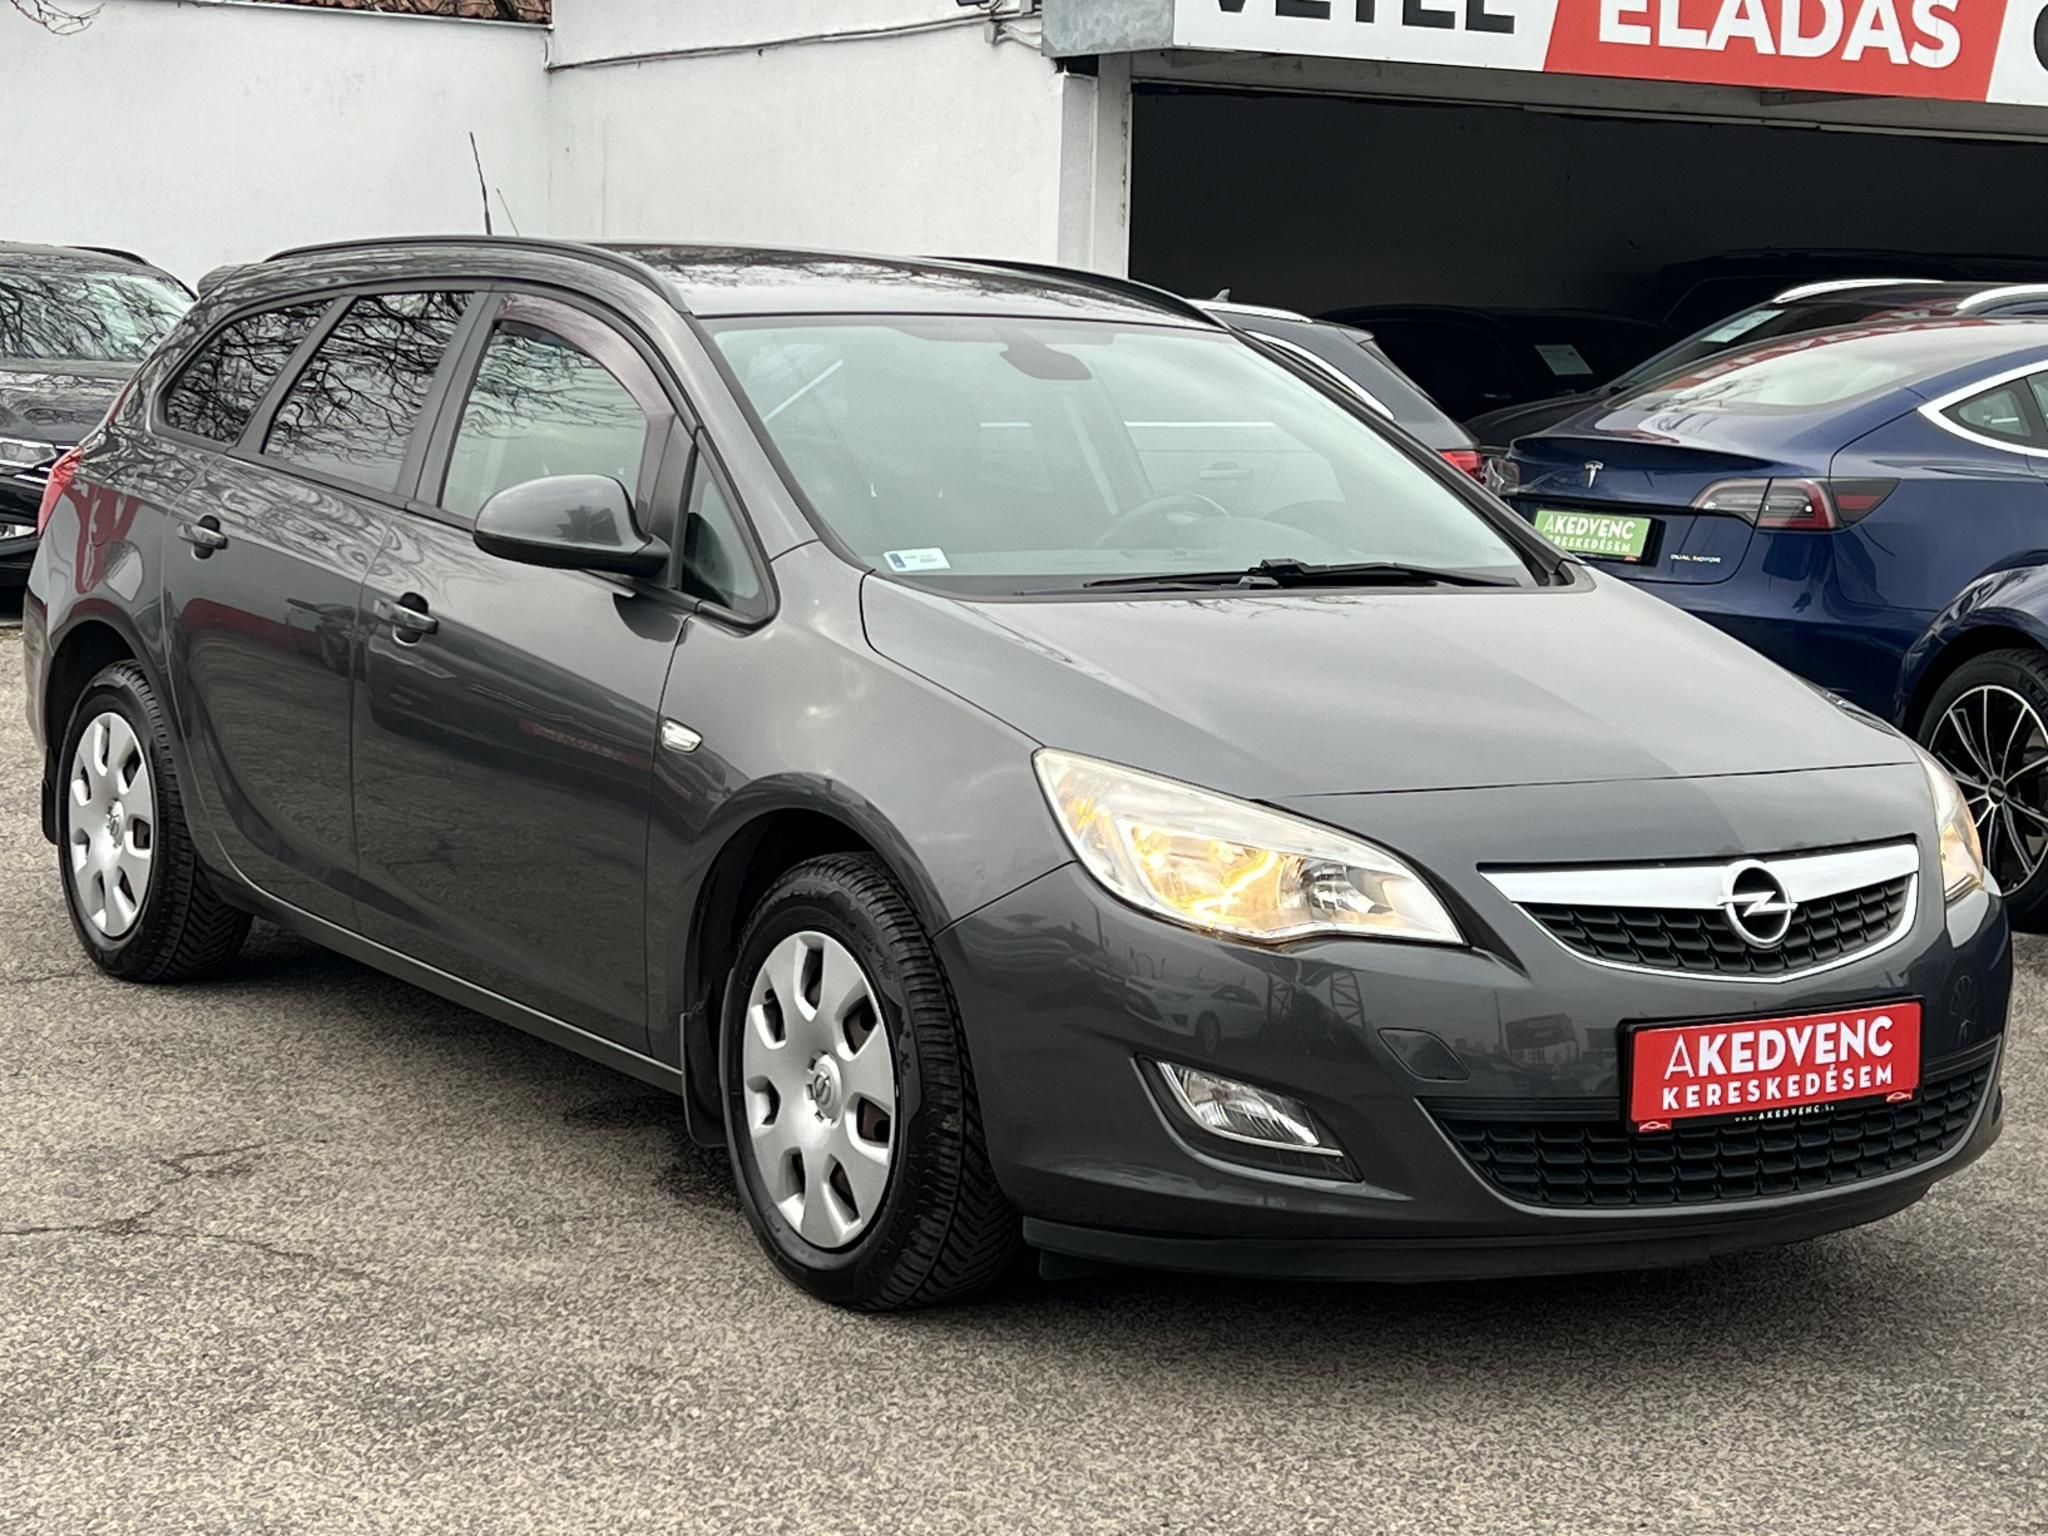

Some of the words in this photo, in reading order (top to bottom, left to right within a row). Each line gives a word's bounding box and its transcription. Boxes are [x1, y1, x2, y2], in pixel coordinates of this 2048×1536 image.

[1543, 514, 1636, 540] AKEDVENC
[1547, 534, 1632, 553] RESKEDÉSEM
[1663, 1015, 1894, 1081] AKEDVENC
[1661, 1062, 1893, 1111] KERESKEDÉSEM
